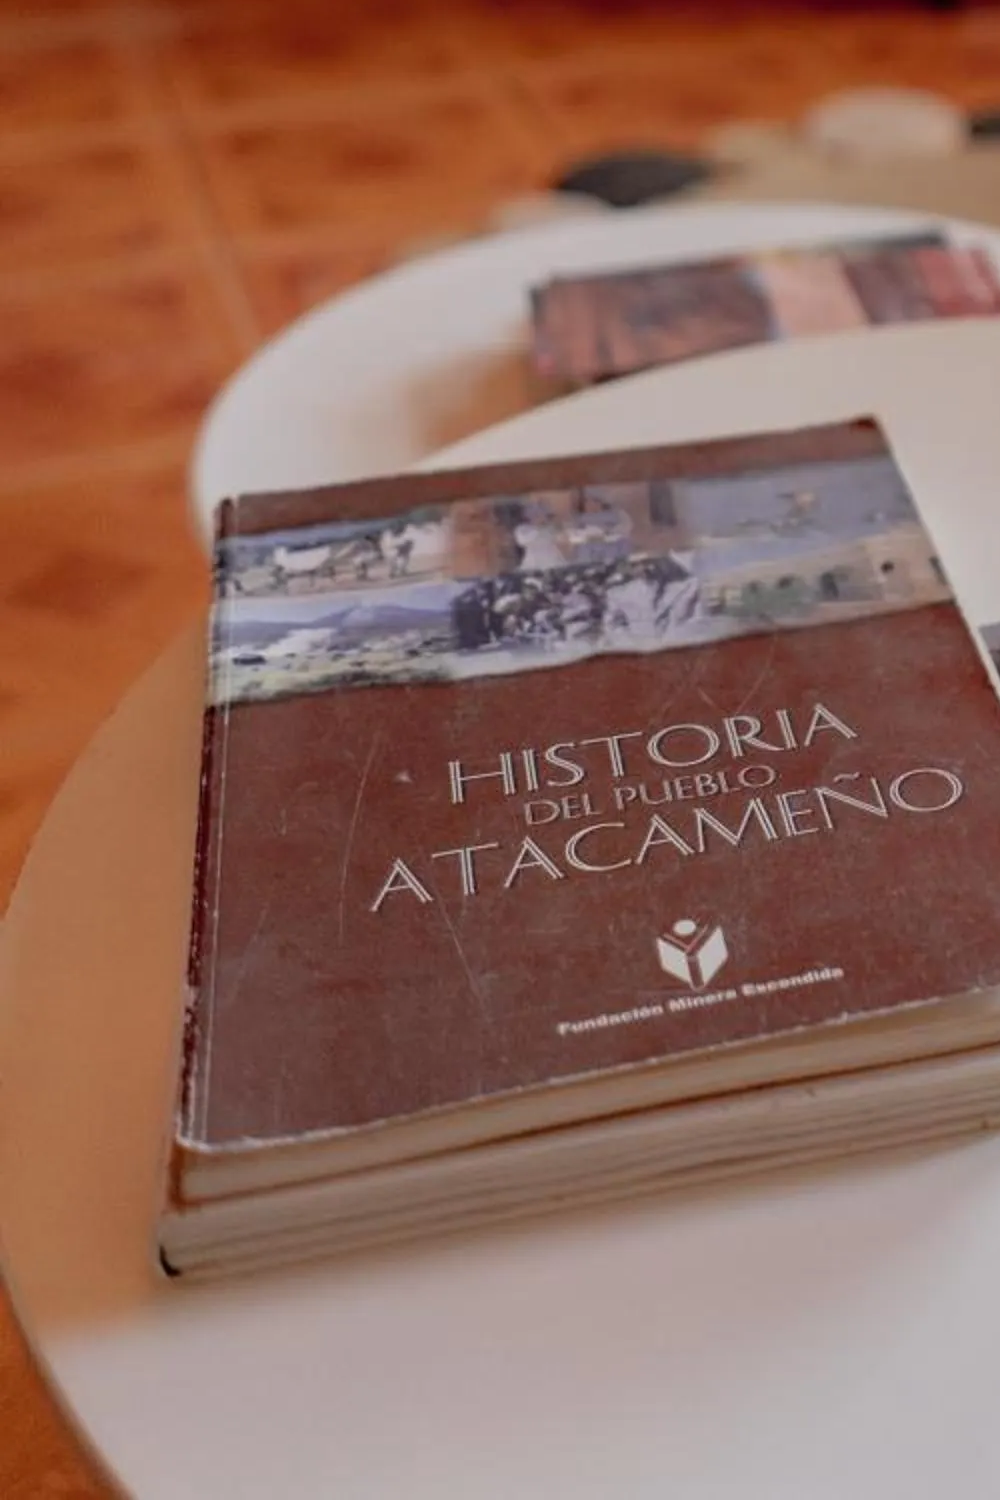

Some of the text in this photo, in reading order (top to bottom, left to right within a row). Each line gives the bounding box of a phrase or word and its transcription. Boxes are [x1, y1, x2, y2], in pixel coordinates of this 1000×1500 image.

[447, 702, 859, 805] HISTORIA
[523, 764, 777, 826] DEL PUEBLO
[370, 768, 965, 913] ATACAMEÑO
[556, 965, 845, 1036] Fundación Minera Escondida
